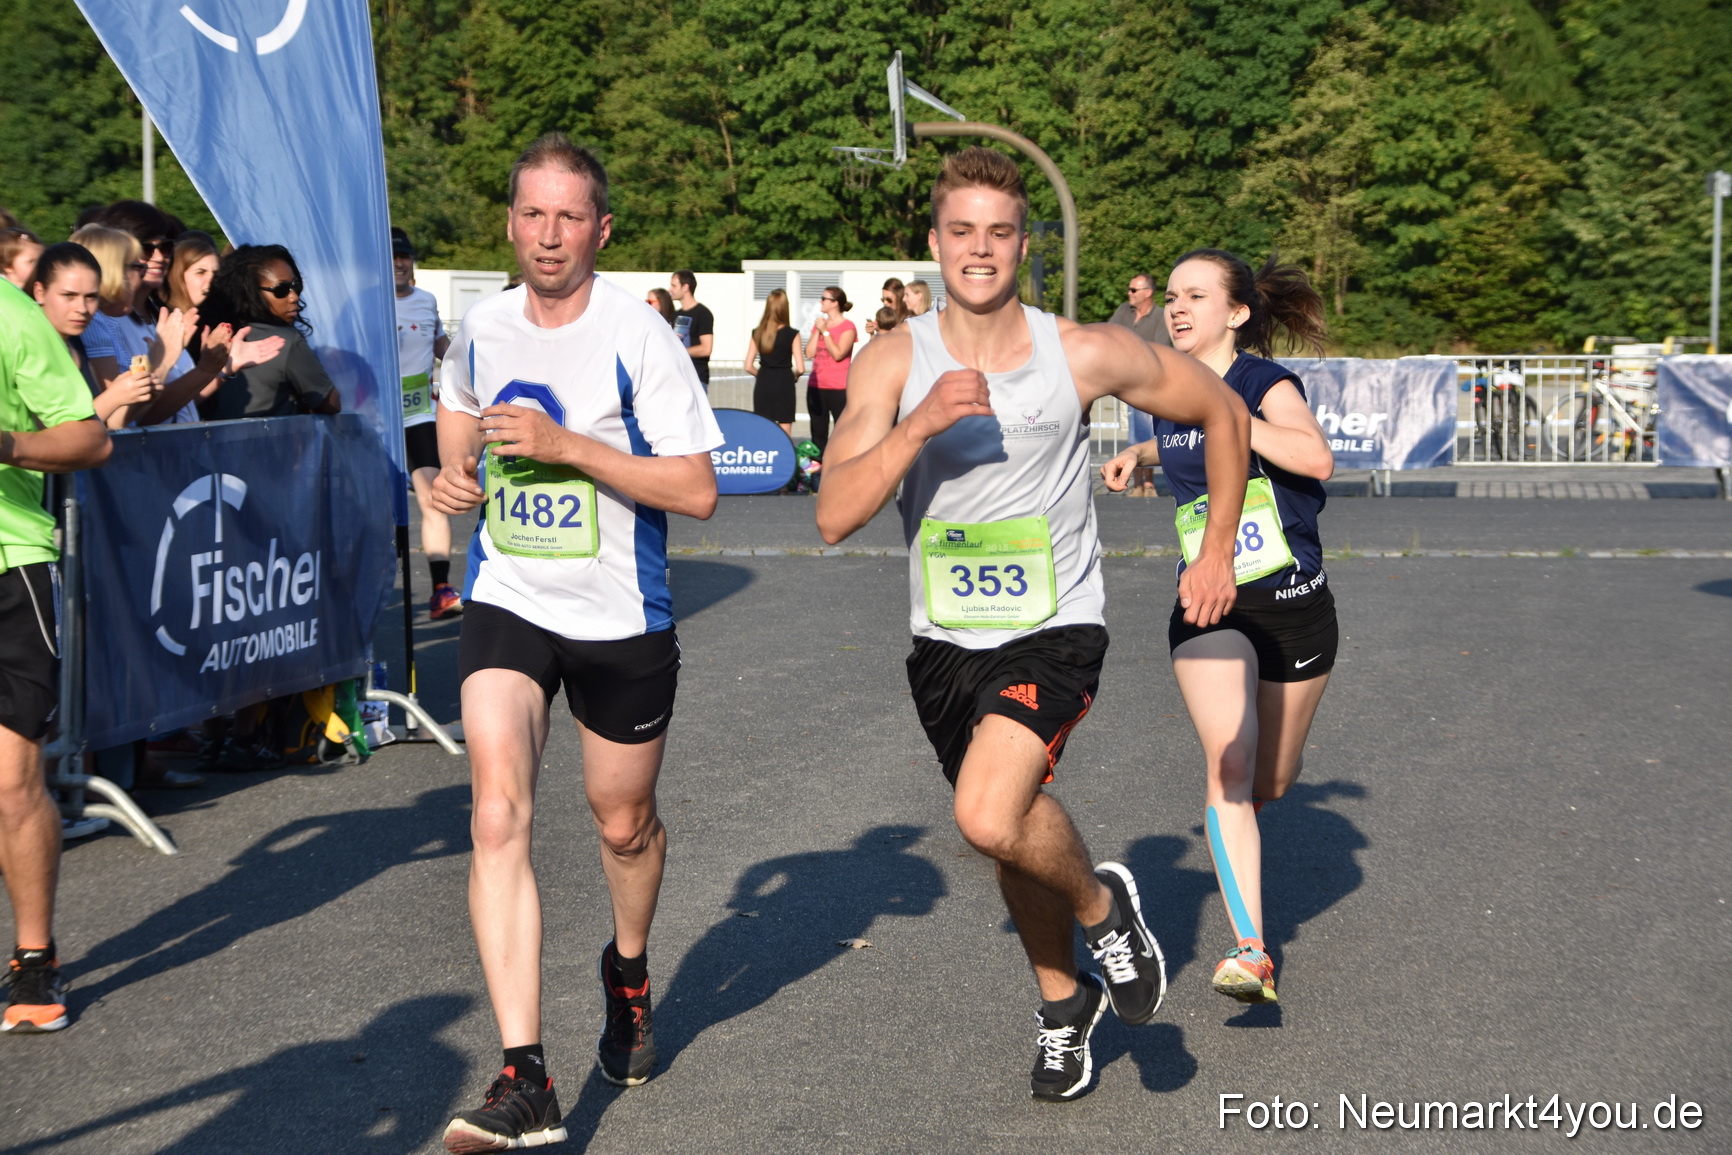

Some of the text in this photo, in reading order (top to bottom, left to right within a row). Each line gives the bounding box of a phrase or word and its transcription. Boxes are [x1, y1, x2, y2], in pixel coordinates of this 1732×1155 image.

[1001, 422, 1060, 434] PLATZHIRSCH
[1327, 439, 1374, 452] BILE
[494, 486, 582, 528] 1482
[511, 532, 557, 543] Jochen Ferstl
[950, 564, 1028, 597] 353
[1275, 583, 1311, 600] NIKE
[961, 604, 1022, 613] Ljubisa Radovic
[200, 617, 318, 674] AUTOMOBILE
[1000, 689, 1040, 710] adidas
